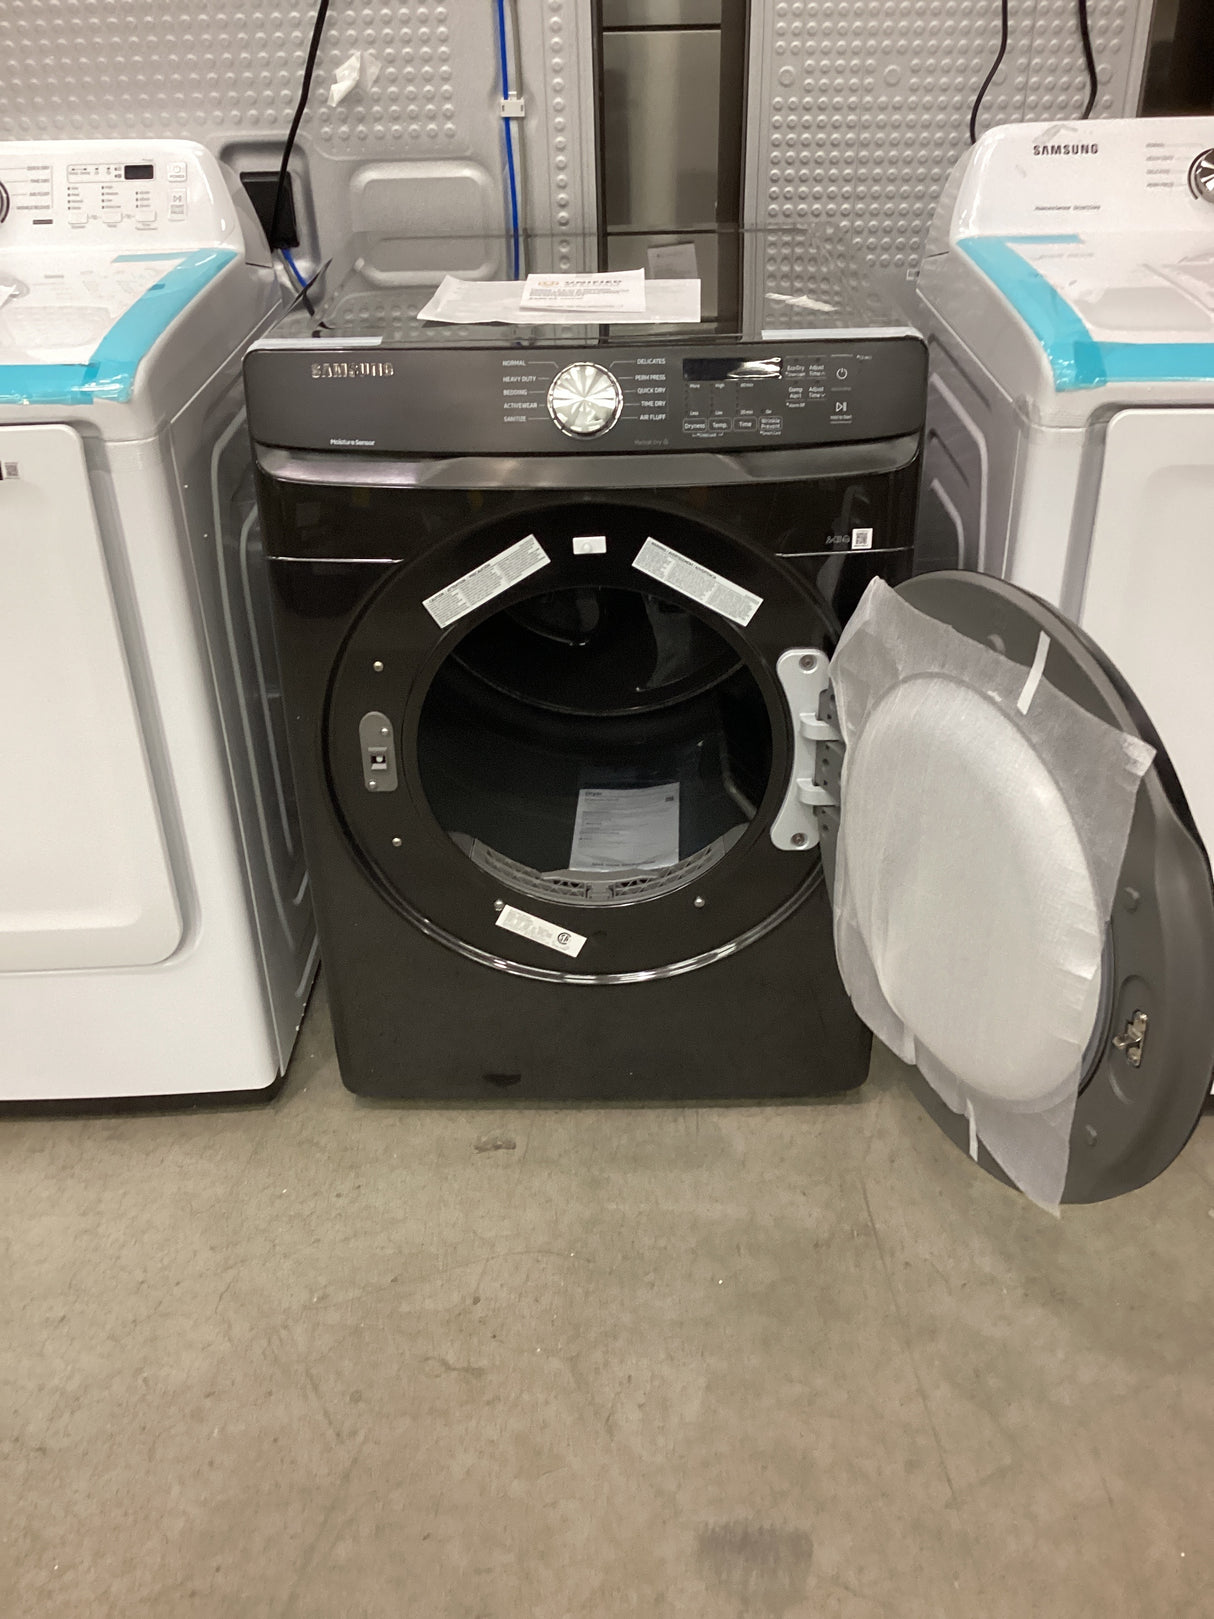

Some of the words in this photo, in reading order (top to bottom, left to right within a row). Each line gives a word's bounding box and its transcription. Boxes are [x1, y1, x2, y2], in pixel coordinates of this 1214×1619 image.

[1033, 143, 1099, 156] SAMSUNG
[311, 362, 394, 379] SAMSUNG
[650, 373, 666, 381] PRESS
[684, 423, 706, 431] Dryness
